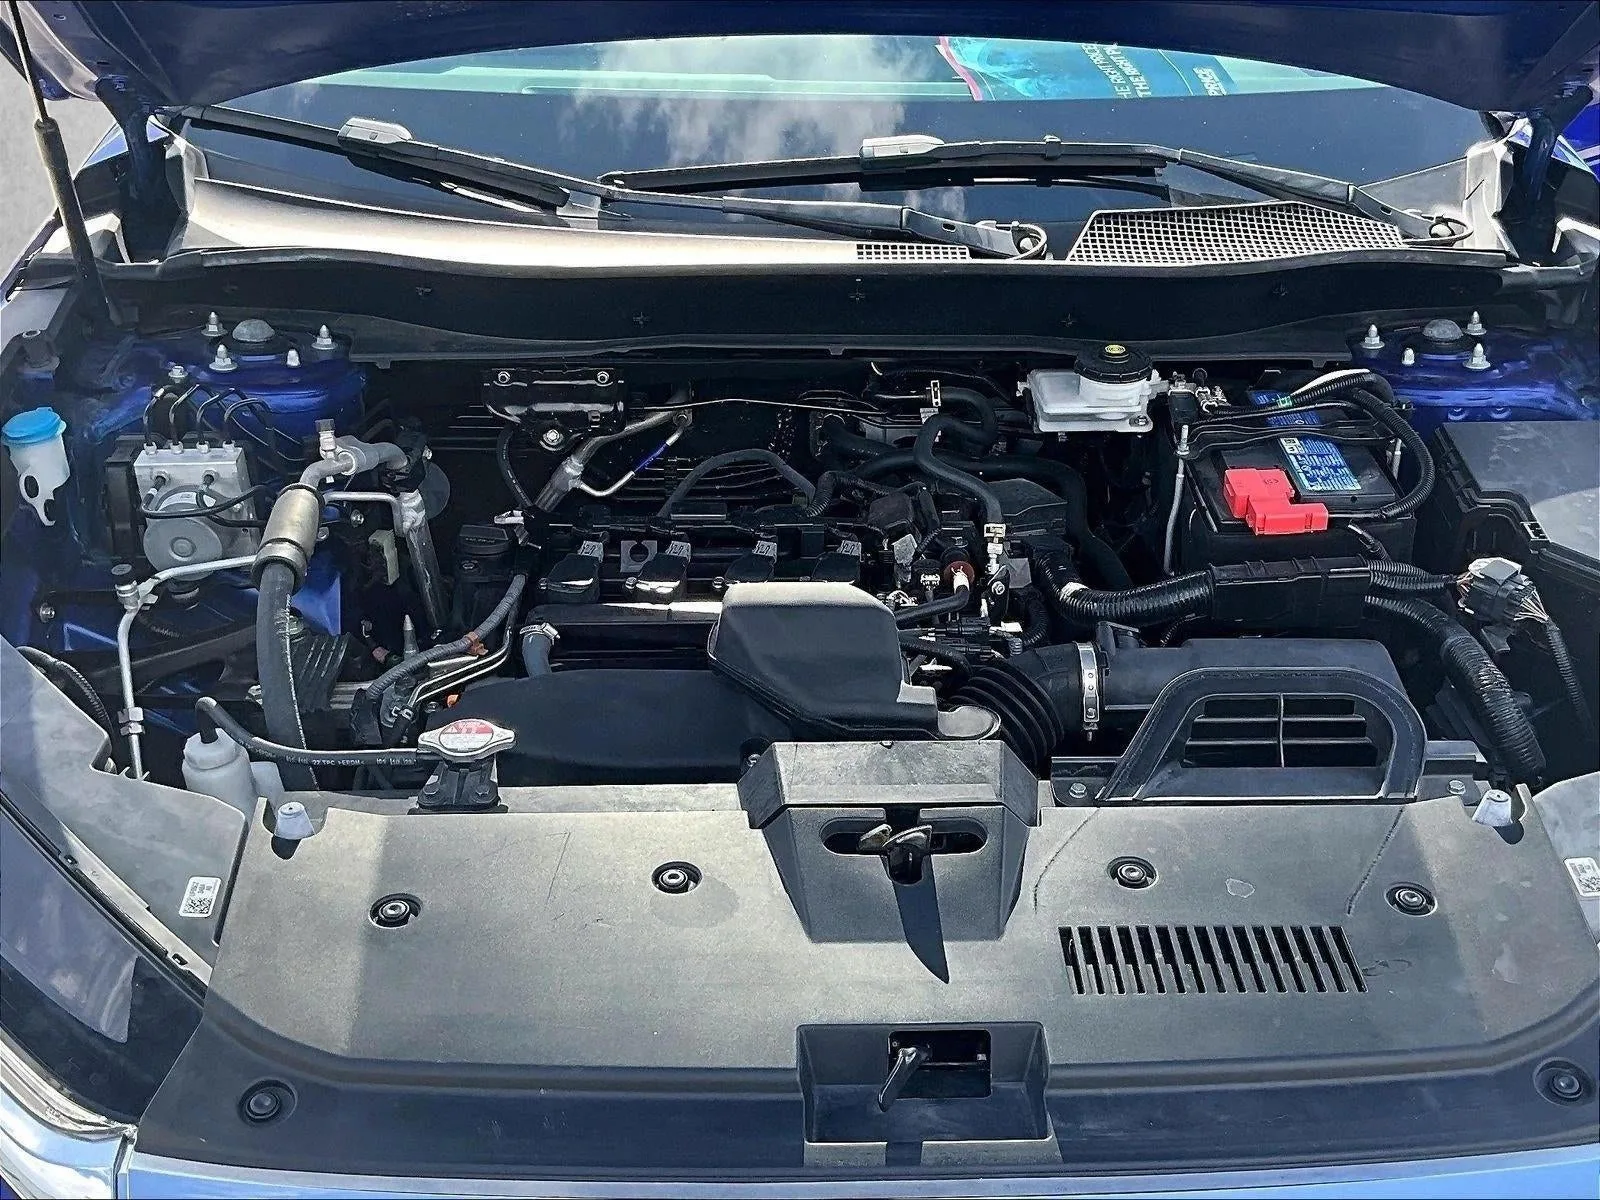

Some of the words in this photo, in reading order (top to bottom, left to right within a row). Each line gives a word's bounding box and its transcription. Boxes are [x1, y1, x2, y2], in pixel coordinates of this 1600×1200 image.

[1097, 65, 1126, 84] RIGHT
[1110, 56, 1141, 76] RIGHT
[1129, 75, 1152, 98] THE
